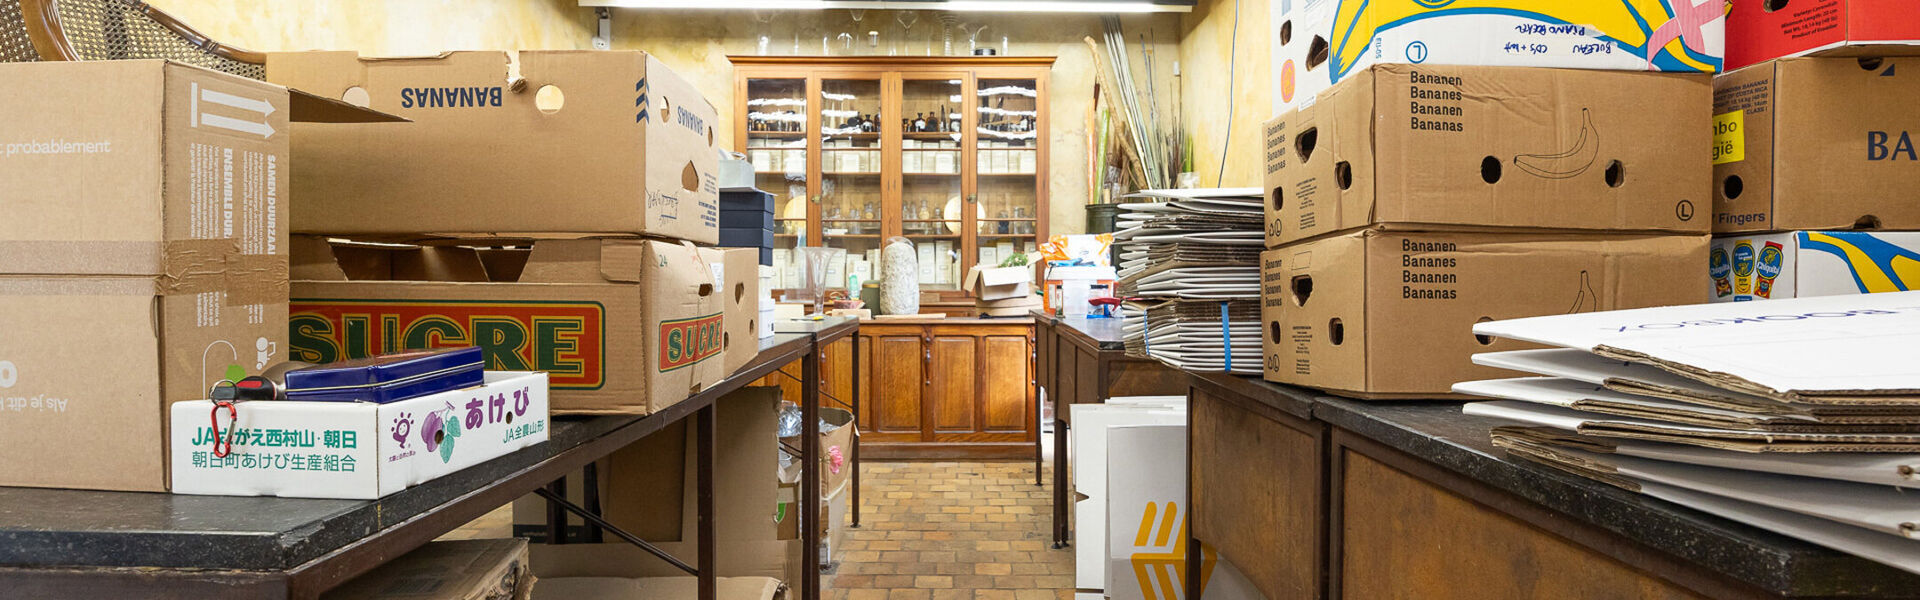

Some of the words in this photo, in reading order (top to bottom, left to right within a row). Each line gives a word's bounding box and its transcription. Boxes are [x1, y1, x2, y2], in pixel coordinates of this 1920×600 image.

[1410, 71, 1462, 86] Bananen
[401, 87, 502, 108] BANANAS
[1410, 86, 1462, 101] Bananes
[1410, 101, 1463, 116] Bananen
[677, 106, 703, 136] BANANAS
[1267, 121, 1286, 137] Bananen
[1411, 117, 1463, 132] Bananas
[6, 139, 111, 157] probablement
[1267, 134, 1286, 150] Bananes
[1267, 147, 1286, 162] Bananen
[267, 154, 277, 197] SAMEN
[1267, 160, 1286, 175] Bananas
[223, 148, 233, 210] ENSEMBLE
[223, 210, 233, 238] DUR
[267, 197, 277, 255] DUURZAA
[1718, 212, 1766, 226] Fingers
[1402, 239, 1456, 252] Bananen
[1402, 254, 1457, 268] Bananes
[1402, 270, 1457, 283] Bananen
[1402, 286, 1457, 300] Bananas
[667, 319, 722, 364] SUCRE
[6, 397, 27, 411] dit
[30, 394, 45, 412] je
[45, 398, 69, 412] Als
[465, 386, 530, 430] あけび
[502, 419, 545, 444] JA全農山形
[192, 451, 357, 472] 朝日町あけび生産組合
